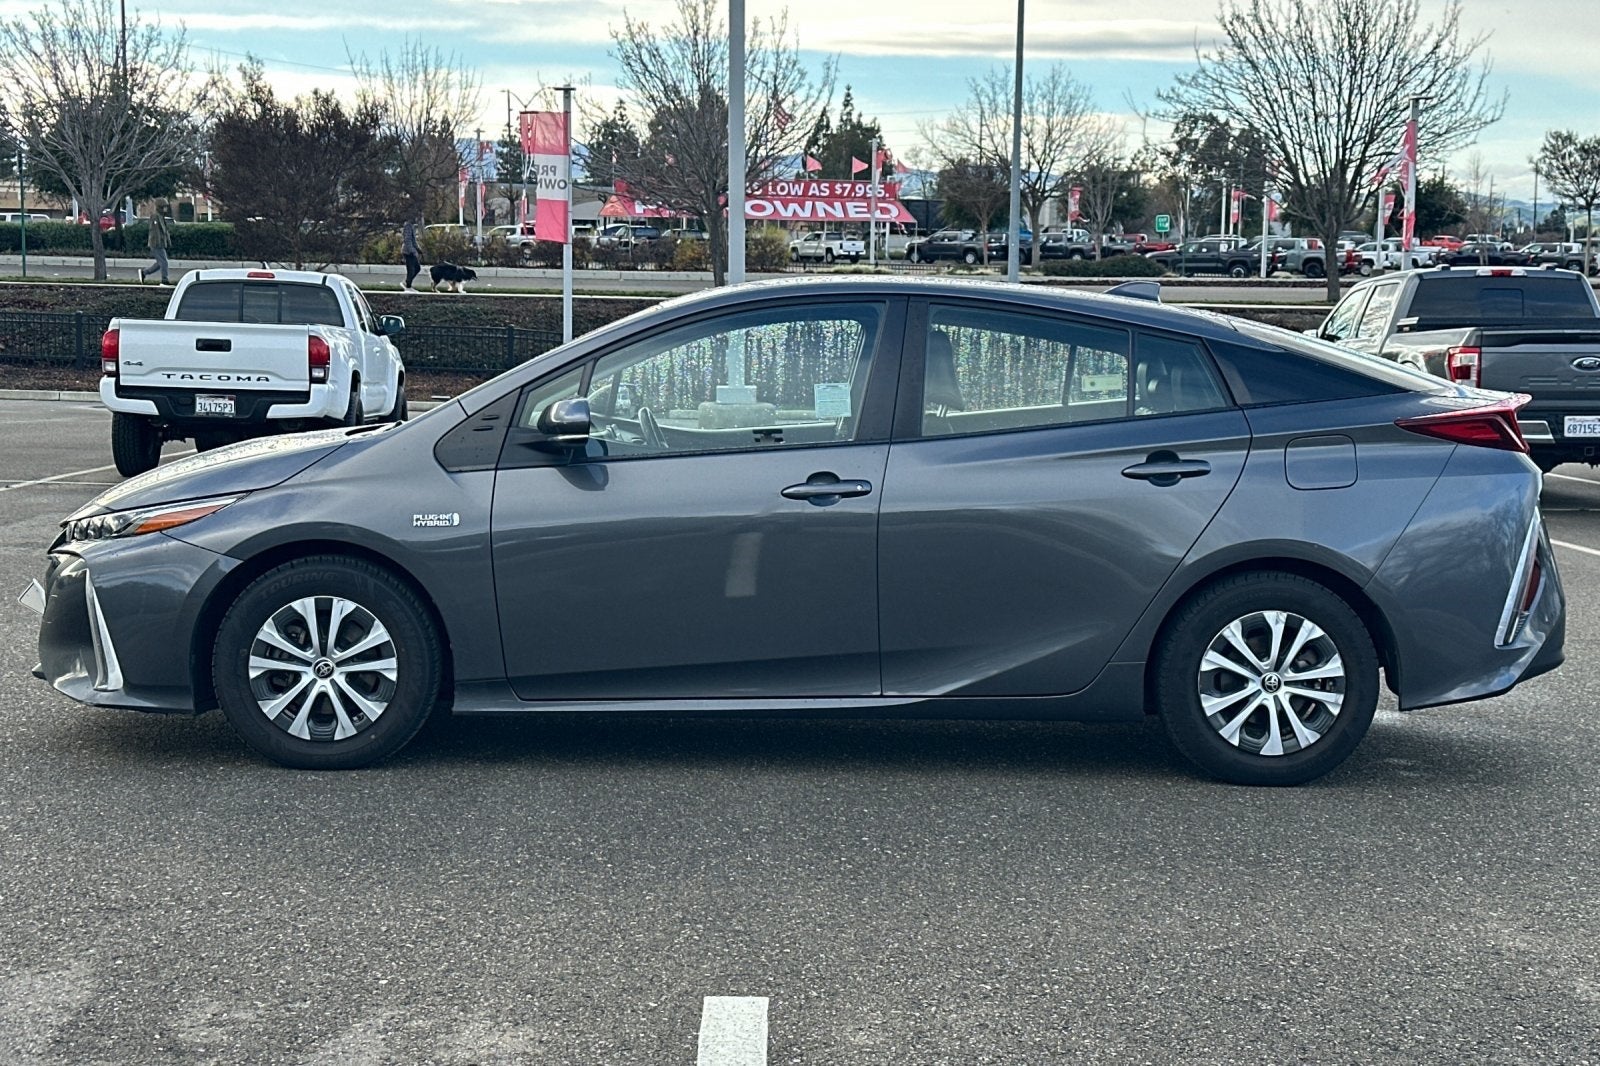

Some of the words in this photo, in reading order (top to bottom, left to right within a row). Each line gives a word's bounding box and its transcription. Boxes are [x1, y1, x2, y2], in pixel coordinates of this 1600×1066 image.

[768, 182, 804, 195] LOW
[808, 183, 829, 196] AS
[745, 200, 899, 218] OWNED
[162, 373, 270, 382] TACOMA
[198, 402, 232, 412] 34175P3
